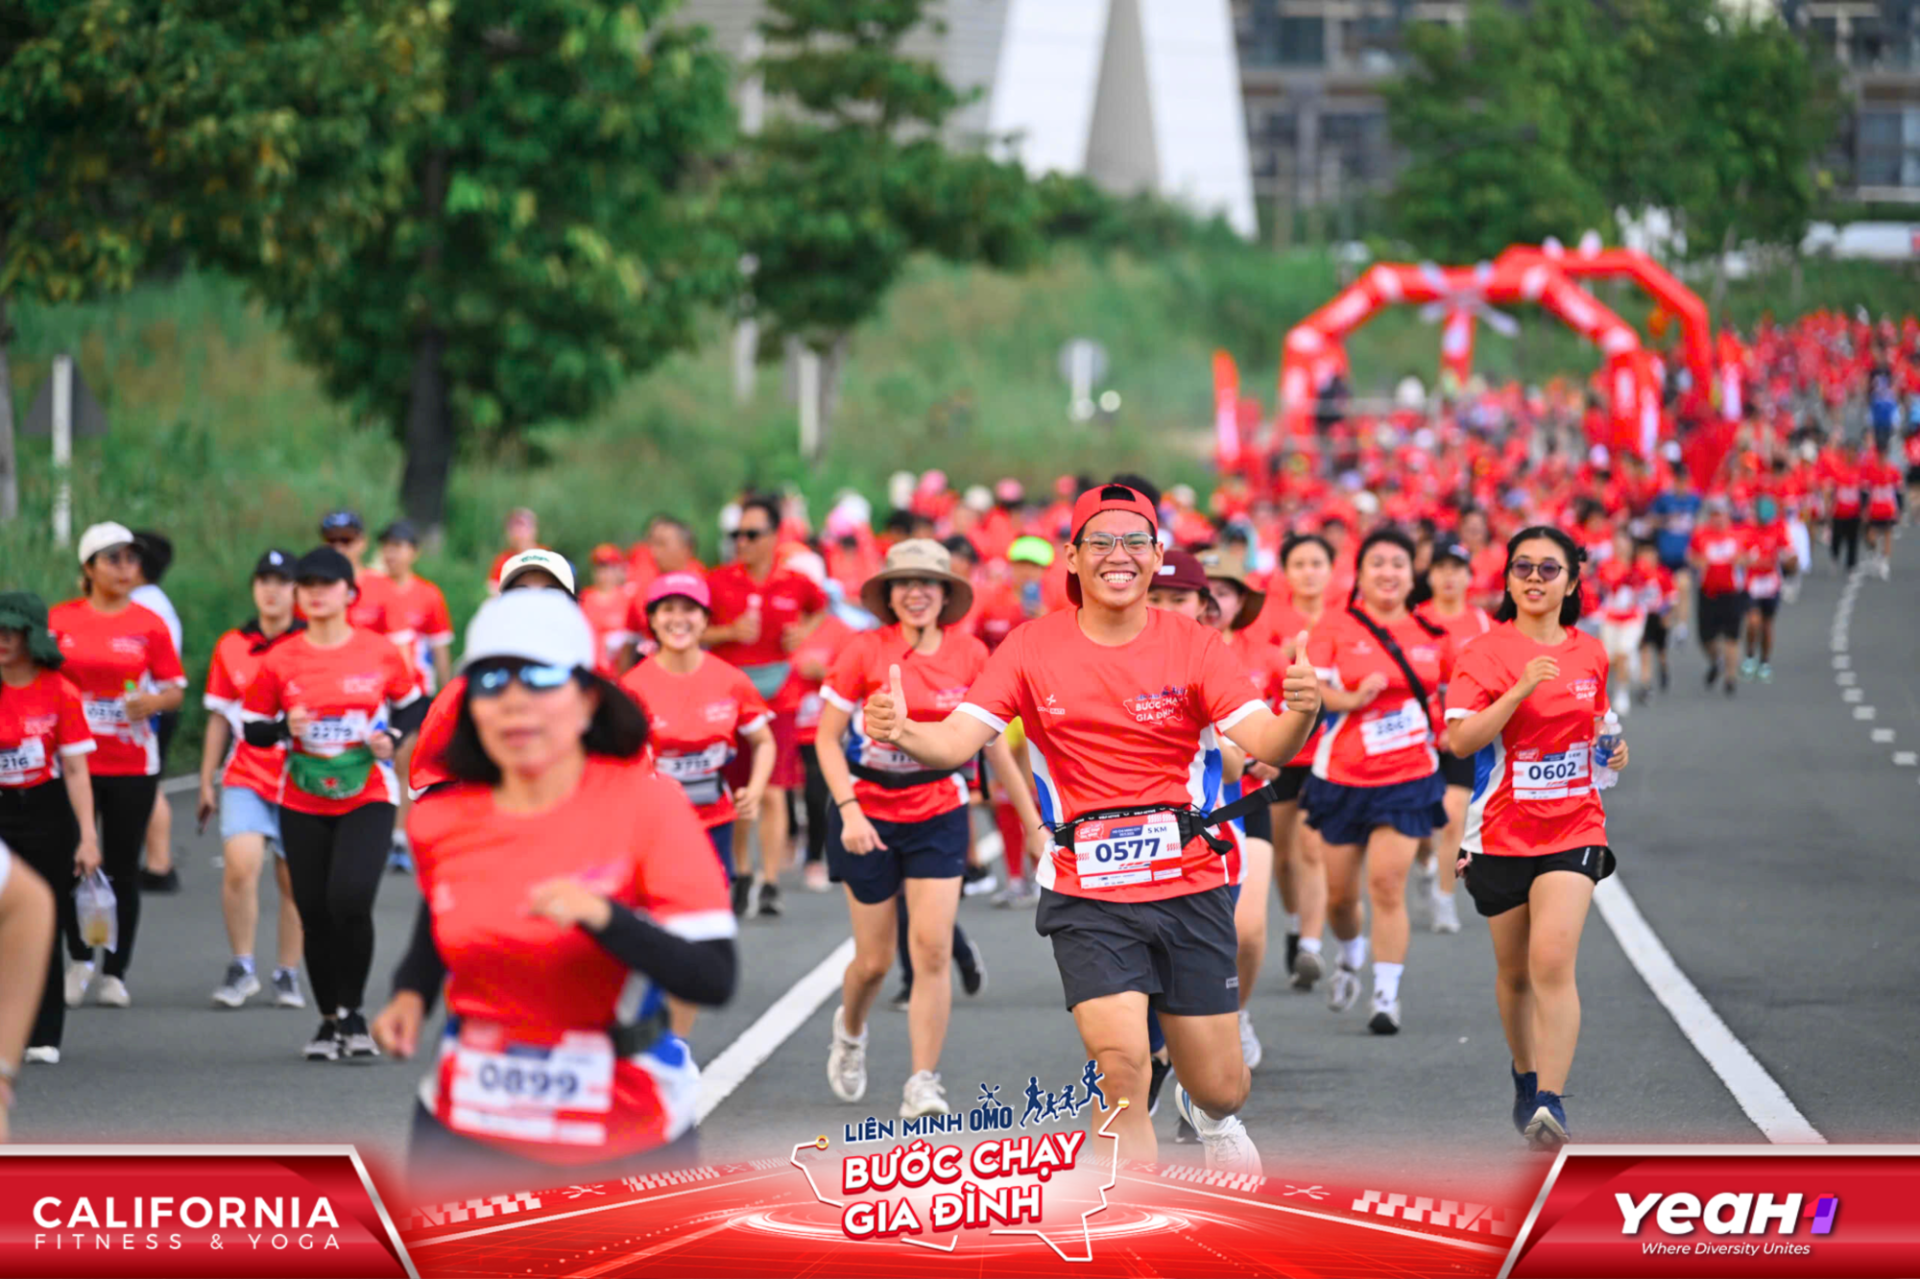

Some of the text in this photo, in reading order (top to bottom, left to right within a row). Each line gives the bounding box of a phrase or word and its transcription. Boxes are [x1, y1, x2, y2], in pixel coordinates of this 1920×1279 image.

[1528, 761, 1577, 780] 0602
[1095, 838, 1160, 863] 0577
[479, 1061, 579, 1099] 0899
